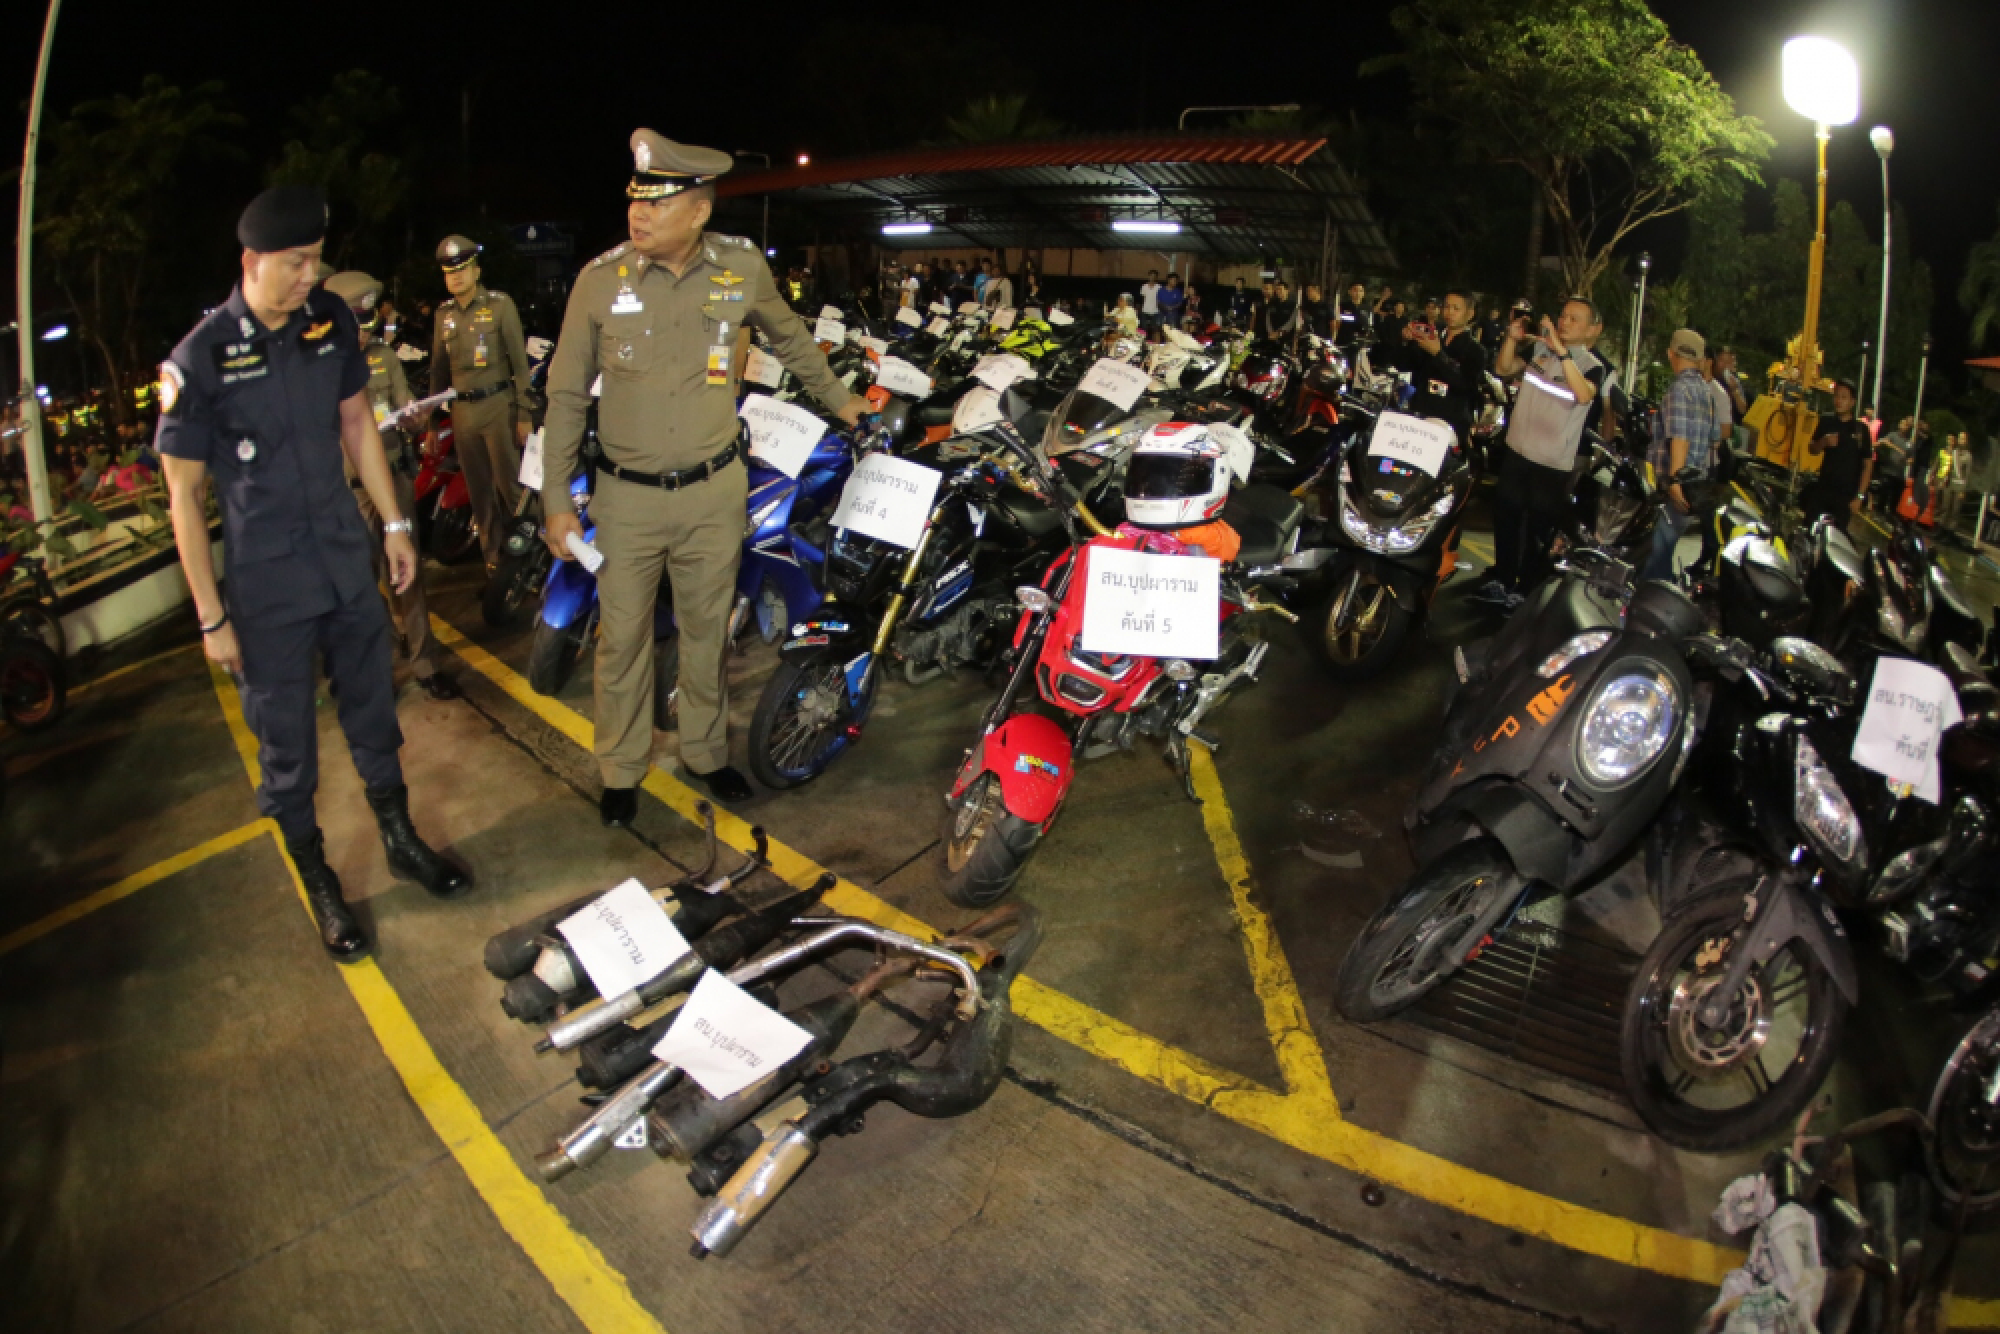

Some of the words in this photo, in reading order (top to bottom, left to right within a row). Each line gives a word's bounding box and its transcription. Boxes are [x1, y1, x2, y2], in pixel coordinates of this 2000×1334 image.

[769, 437, 781, 449] 3
[1411, 445, 1423, 456] 10
[850, 496, 877, 515] คันที่
[877, 507, 888, 521] 4
[1101, 571, 1199, 596] สน.บุปผาราม
[1121, 608, 1155, 633] คันที่
[1161, 617, 1173, 635] 5
[693, 1017, 764, 1069] สน.บุปผาราม
